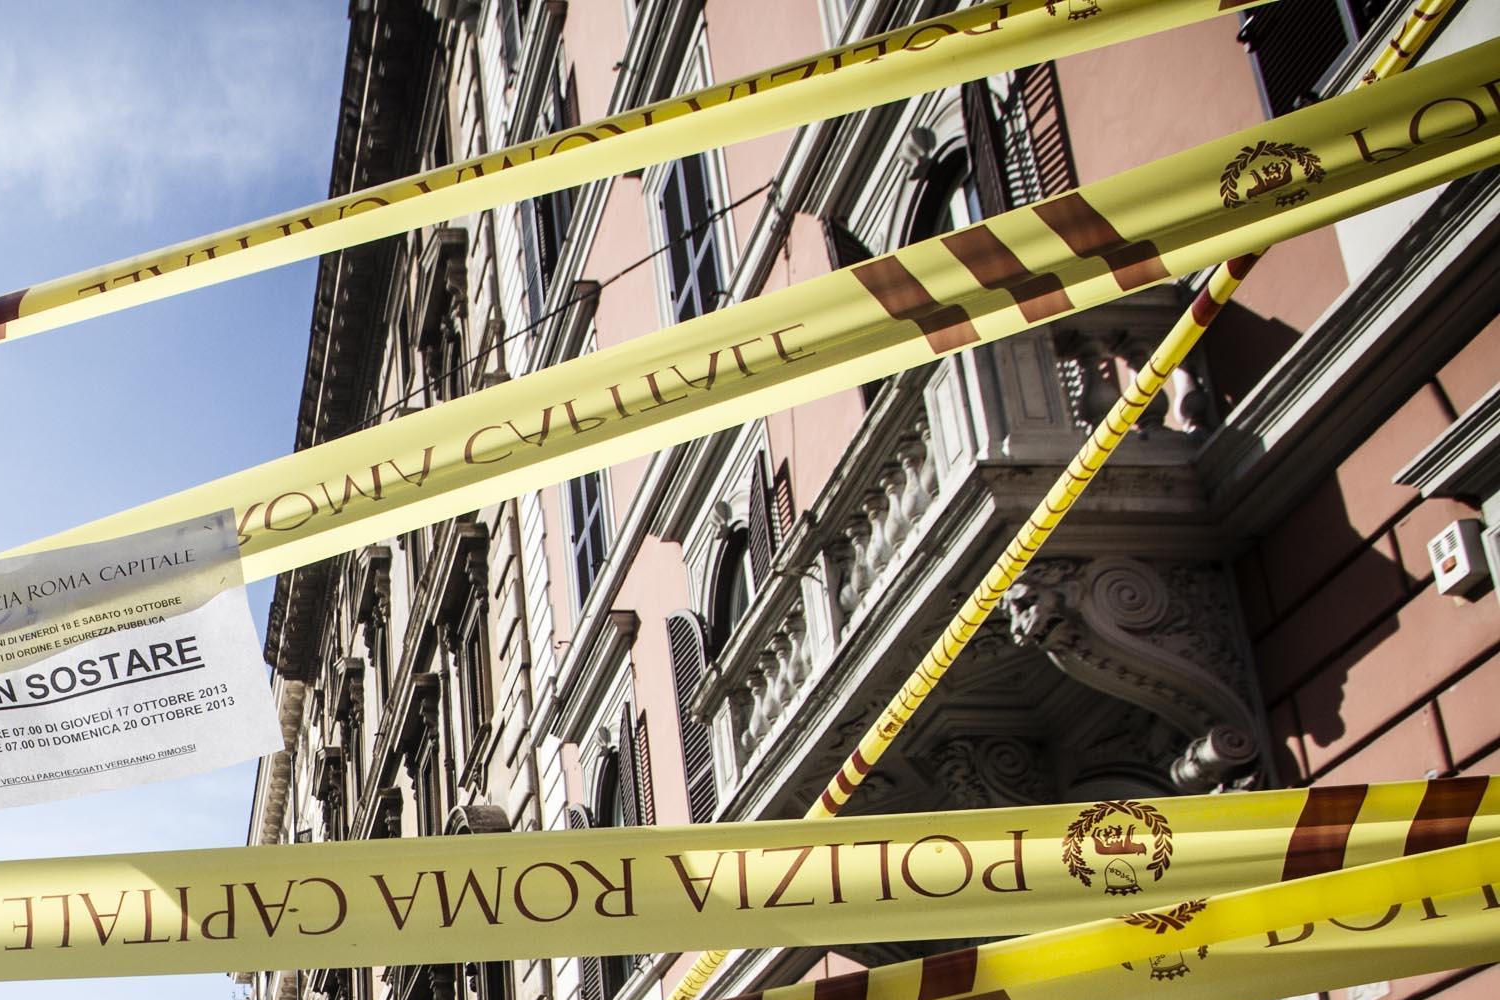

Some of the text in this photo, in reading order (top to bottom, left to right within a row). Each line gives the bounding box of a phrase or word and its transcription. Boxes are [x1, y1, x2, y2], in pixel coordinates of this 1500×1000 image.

[27, 572, 91, 601] ROMA
[99, 549, 196, 582] CAPITALE
[5, 636, 18, 646] DI
[19, 625, 60, 642] VENERDÌ
[61, 622, 72, 632] 18
[74, 619, 82, 628] E
[83, 609, 121, 627] SABATO
[123, 606, 134, 616] 19
[135, 596, 182, 614] OTTOBRE
[5, 652, 16, 662] DI
[16, 643, 53, 659] ORDINE
[54, 639, 61, 648] E
[62, 626, 116, 646] SICUREZZA
[117, 615, 165, 632] PUBBLICA
[27, 636, 202, 700] SOSTARE
[5, 739, 35, 752] 07.00
[38, 736, 51, 747] DI
[52, 723, 121, 747] DOMENICA
[124, 719, 138, 732] 20
[141, 704, 203, 727] OTTOBRE
[206, 696, 235, 713] 2013
[12, 725, 42, 737] 07.00
[45, 722, 58, 733] DI
[60, 707, 113, 732] GIOVEDÌ
[116, 706, 129, 718] 17
[133, 691, 196, 714] OTTOBRE
[199, 683, 228, 700] 2013
[2, 773, 35, 786] VEICOLI
[36, 763, 103, 781] PARCHEGGIATI
[104, 752, 156, 771] VERRANNO
[157, 744, 196, 759] RIMOSSI
[4, 829, 1032, 952] POLIZIA ROMA CAPITALE
